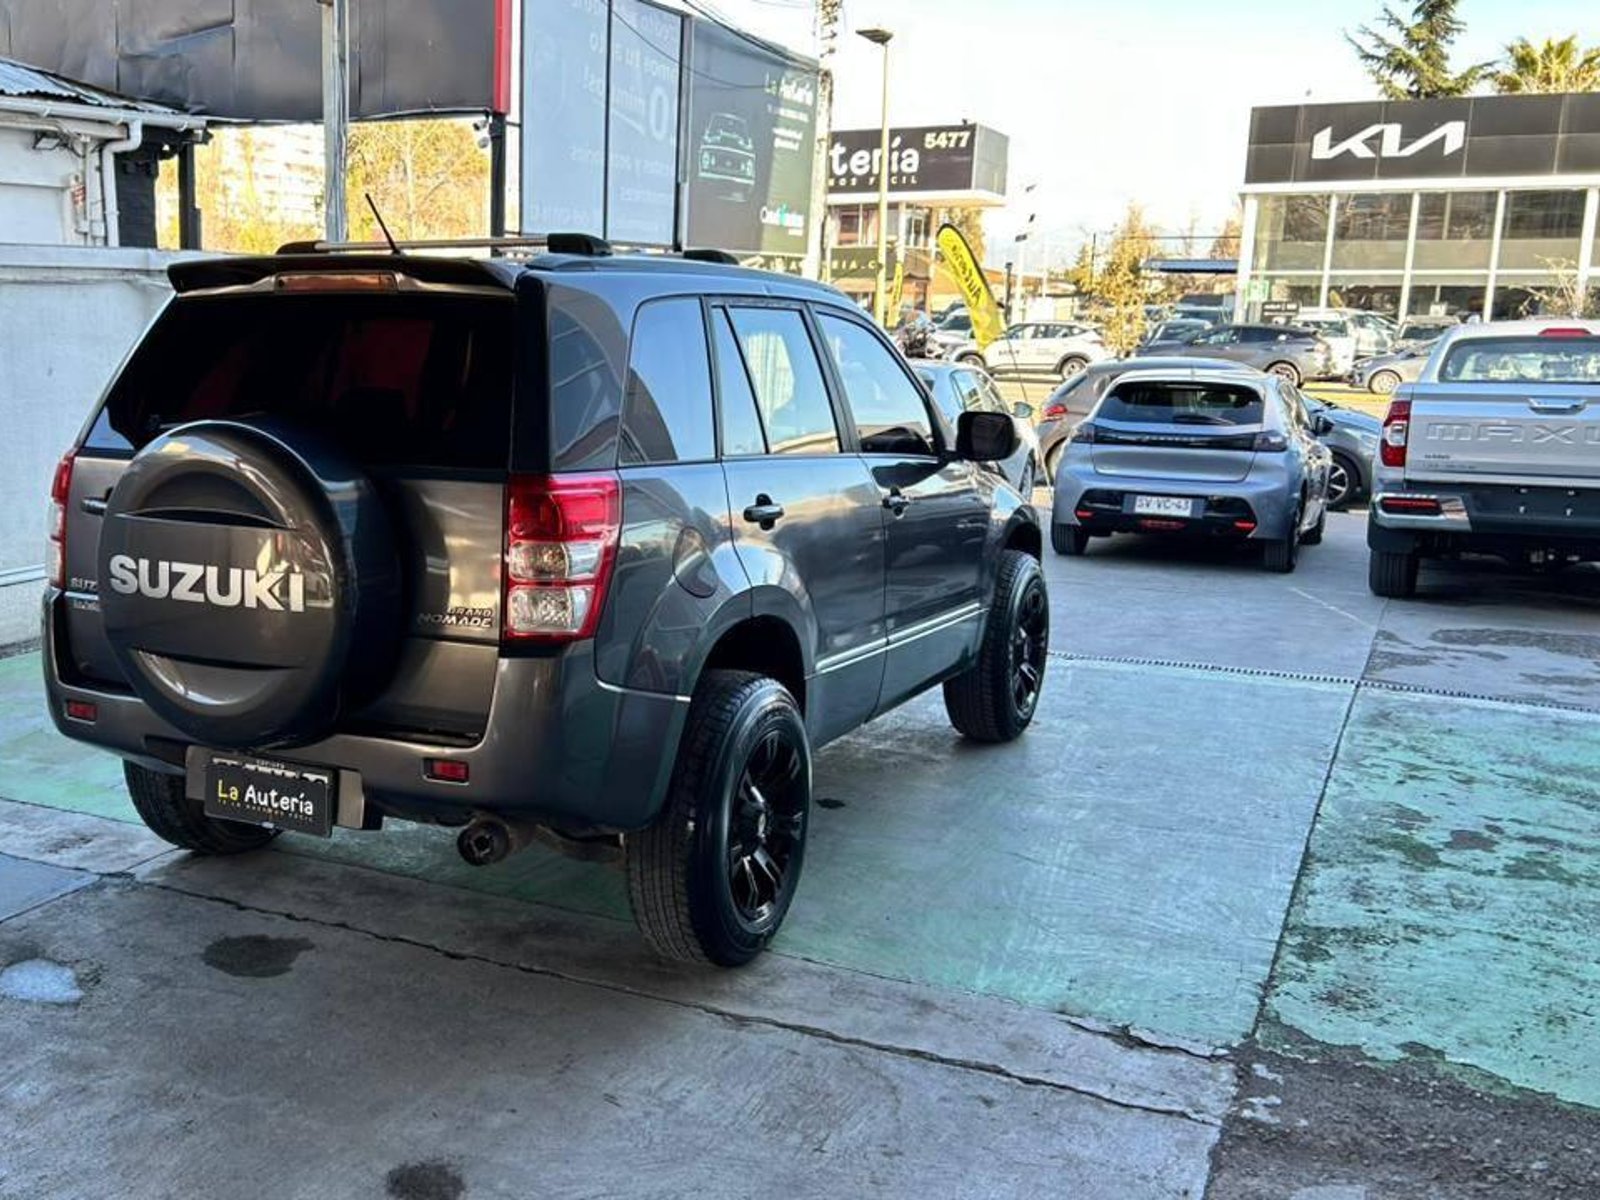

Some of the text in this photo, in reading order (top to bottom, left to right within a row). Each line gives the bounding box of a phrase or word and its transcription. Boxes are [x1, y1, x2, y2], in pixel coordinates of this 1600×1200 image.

[924, 131, 971, 149] 5477
[1311, 120, 1465, 159] KIA
[109, 554, 305, 613] SUZUKI
[418, 613, 492, 628] NOMADE
[218, 779, 239, 801] La
[244, 784, 313, 816] Autería
